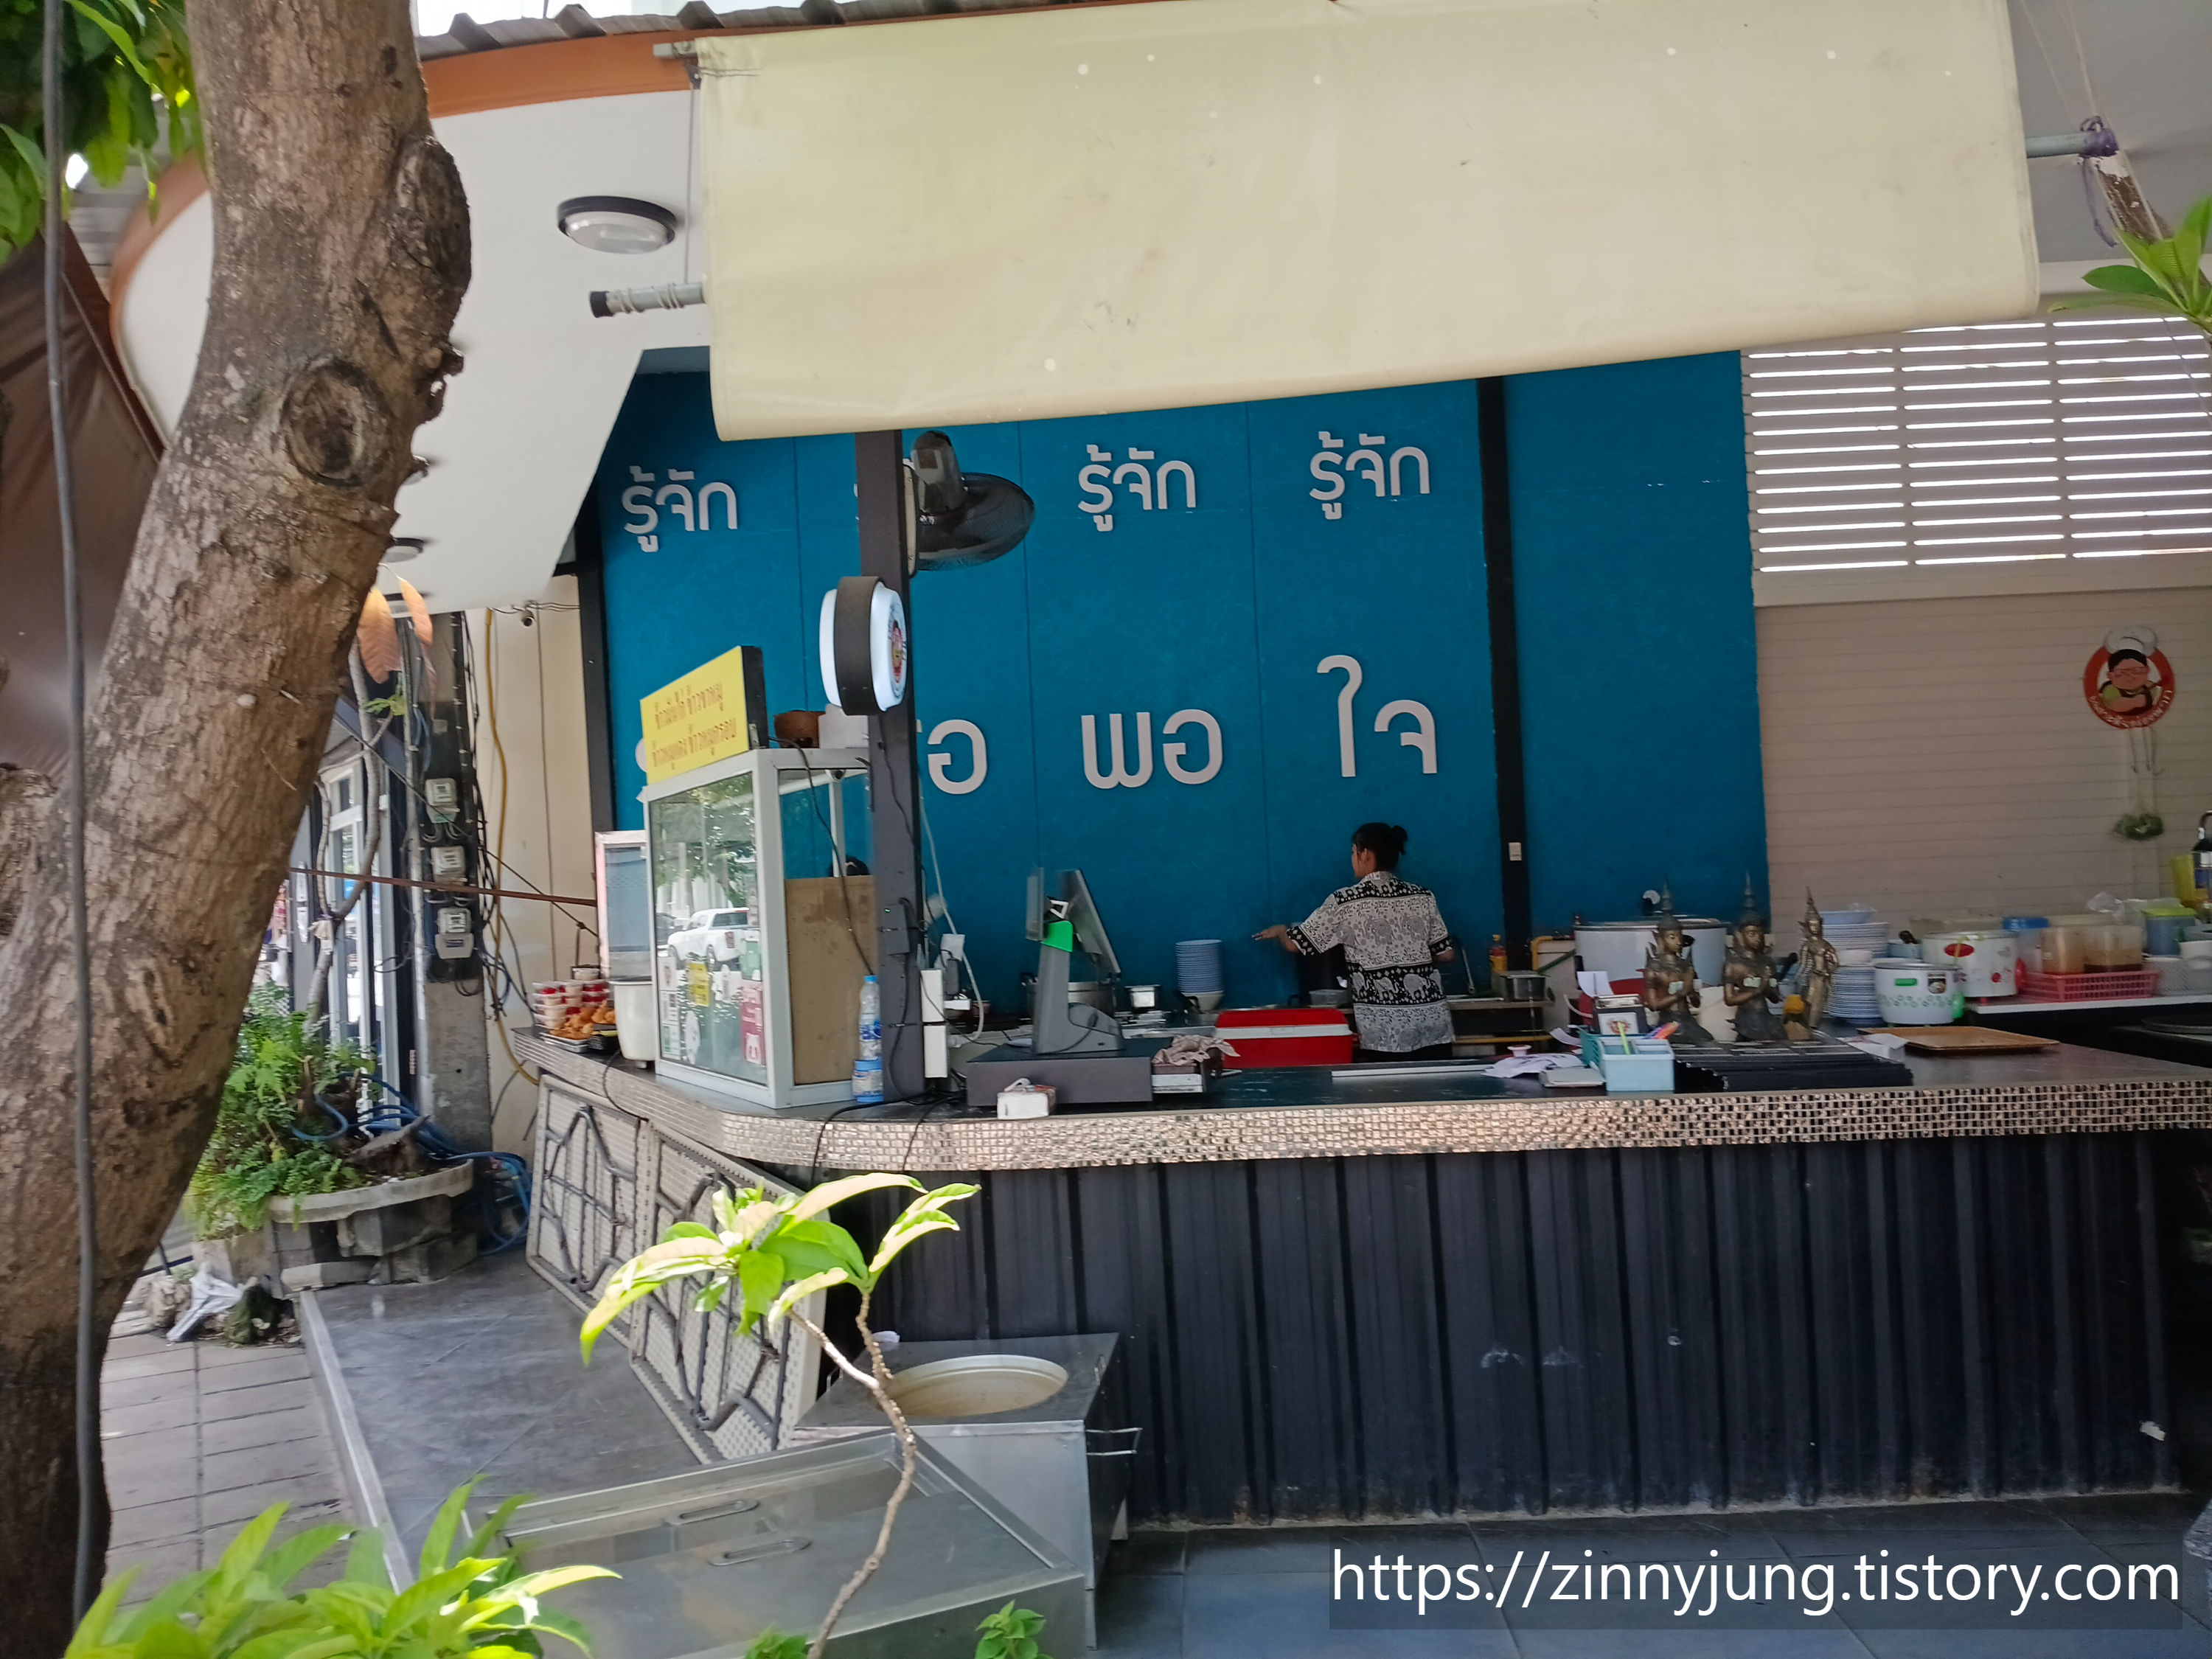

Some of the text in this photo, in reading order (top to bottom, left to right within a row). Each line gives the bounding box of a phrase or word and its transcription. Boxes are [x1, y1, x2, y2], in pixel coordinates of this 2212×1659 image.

[621, 431, 1430, 552] รู้จัก รู้จัก รู้จัก
[917, 655, 1437, 795] อ พอ ใจ
